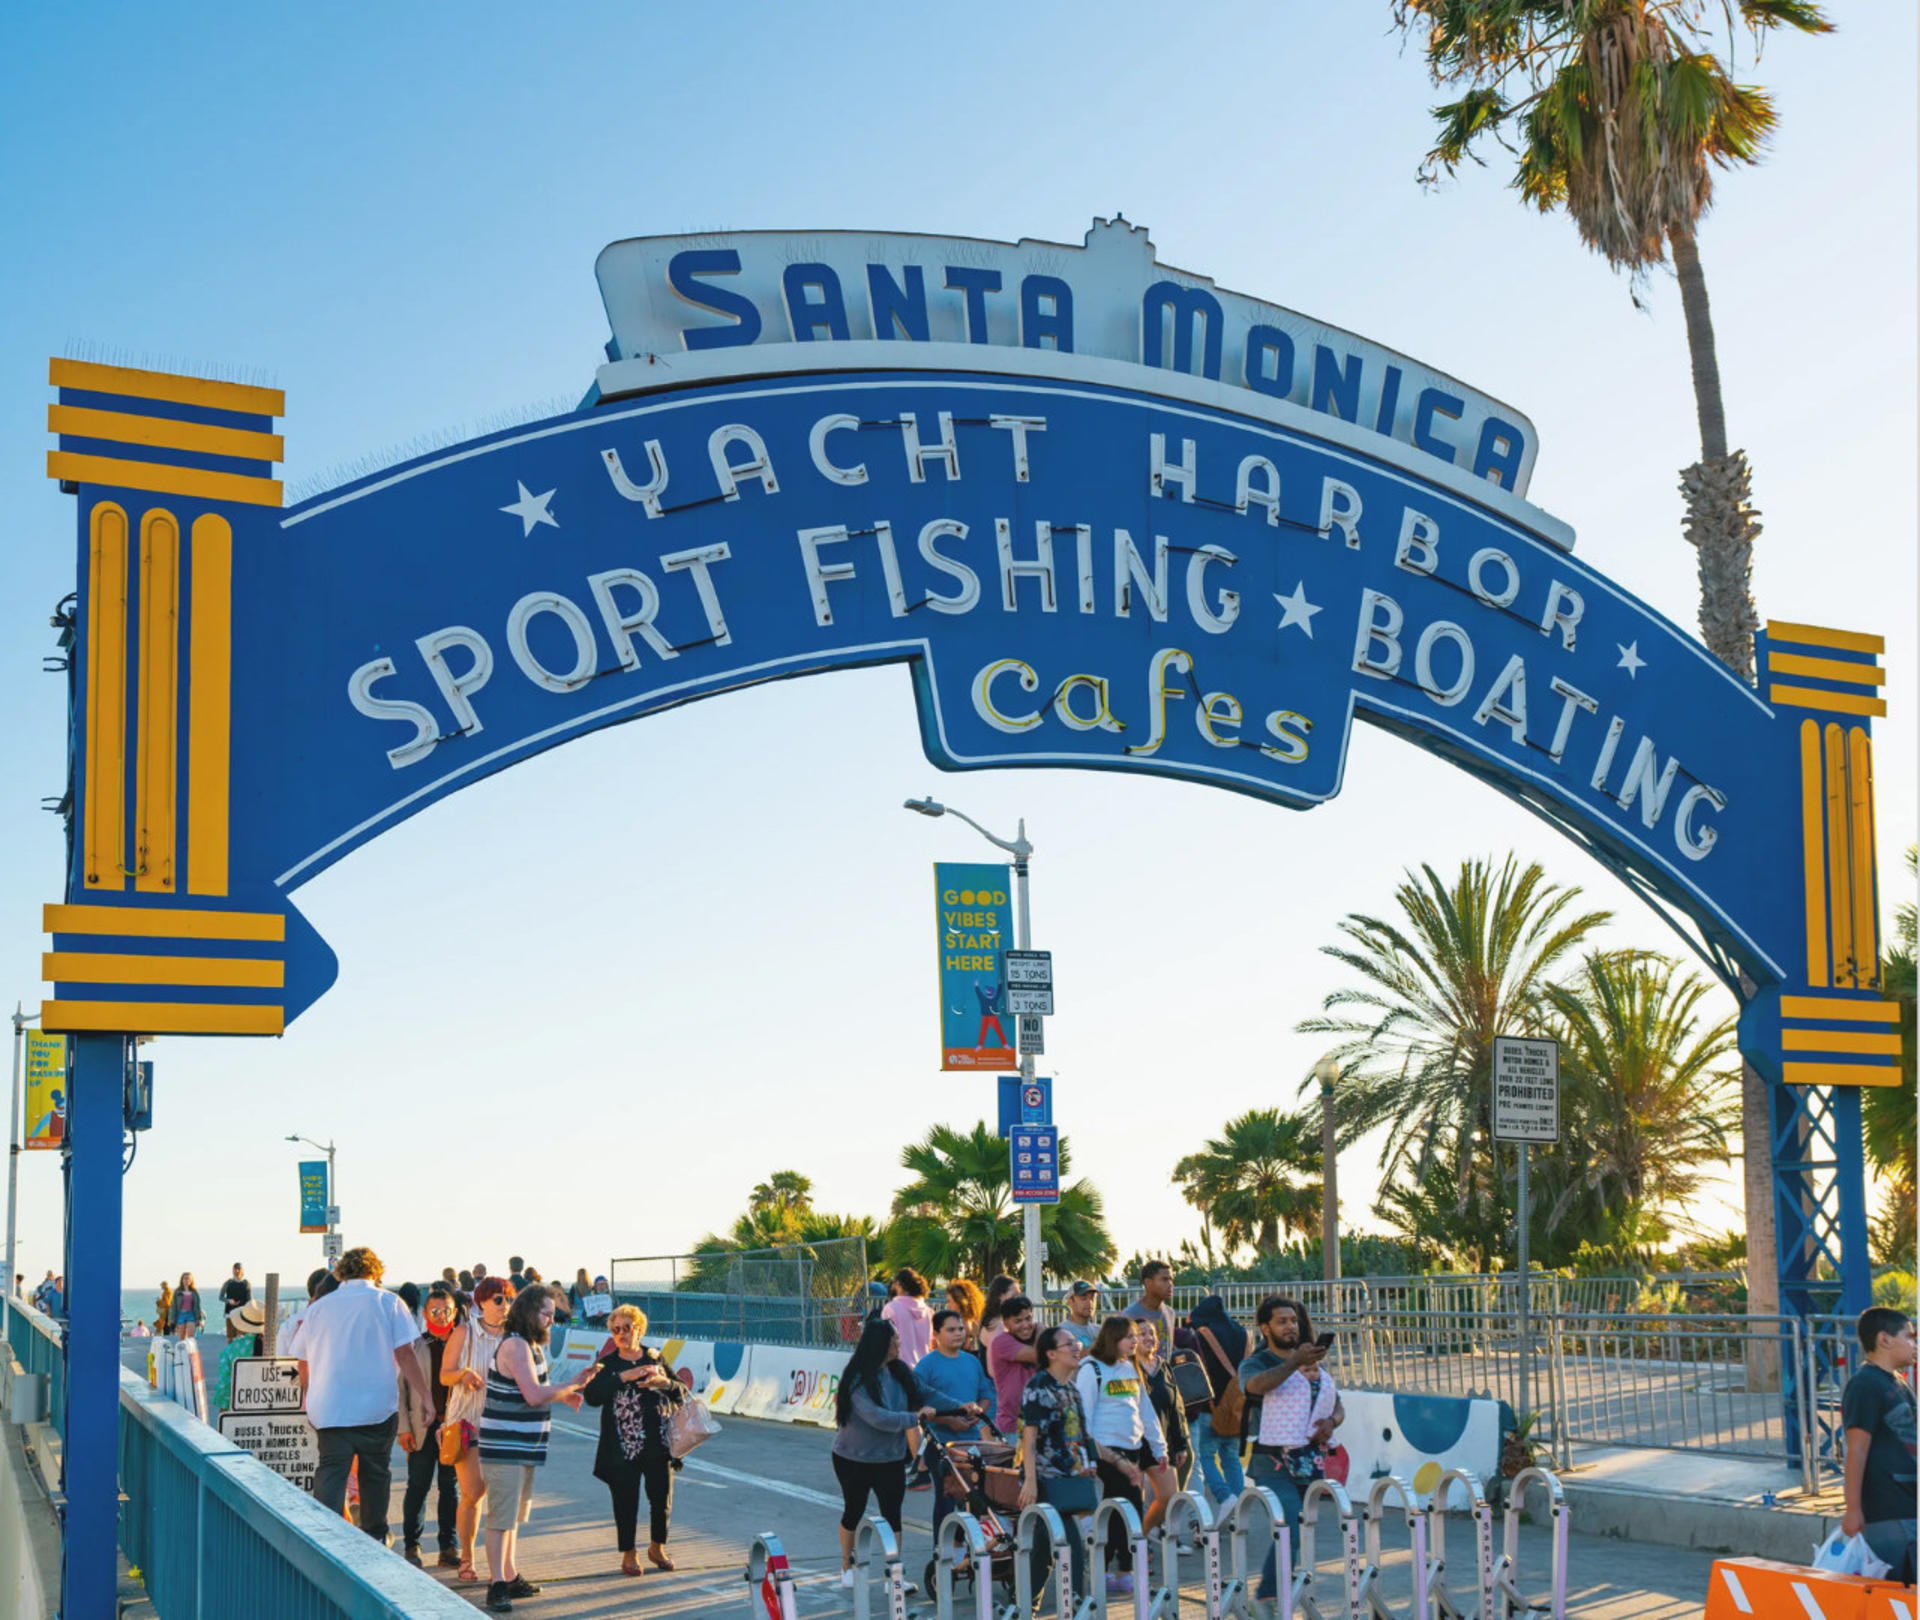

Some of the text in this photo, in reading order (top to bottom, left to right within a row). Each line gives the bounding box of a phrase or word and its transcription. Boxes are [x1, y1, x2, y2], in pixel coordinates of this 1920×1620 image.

[666, 248, 1525, 494] SANTA MONICA
[600, 411, 1586, 653] YACHT HARBOR
[347, 518, 1727, 861] SPORT FISHING BOATING
[943, 889, 1006, 906] GOOD
[944, 911, 997, 927] VIBES
[945, 933, 1001, 949] START
[946, 955, 995, 971] HERE
[1023, 970, 1047, 979] TONS
[1024, 1002, 1047, 1010] TONS
[1023, 1019, 1039, 1032] NO
[1498, 1085, 1554, 1100] PROHIBITED
[262, 1366, 280, 1382] USE
[238, 1387, 298, 1404] CROSSWALK
[266, 1438, 297, 1448] HOMES
[301, 1437, 308, 1447] &
[290, 1462, 314, 1472] LONG
